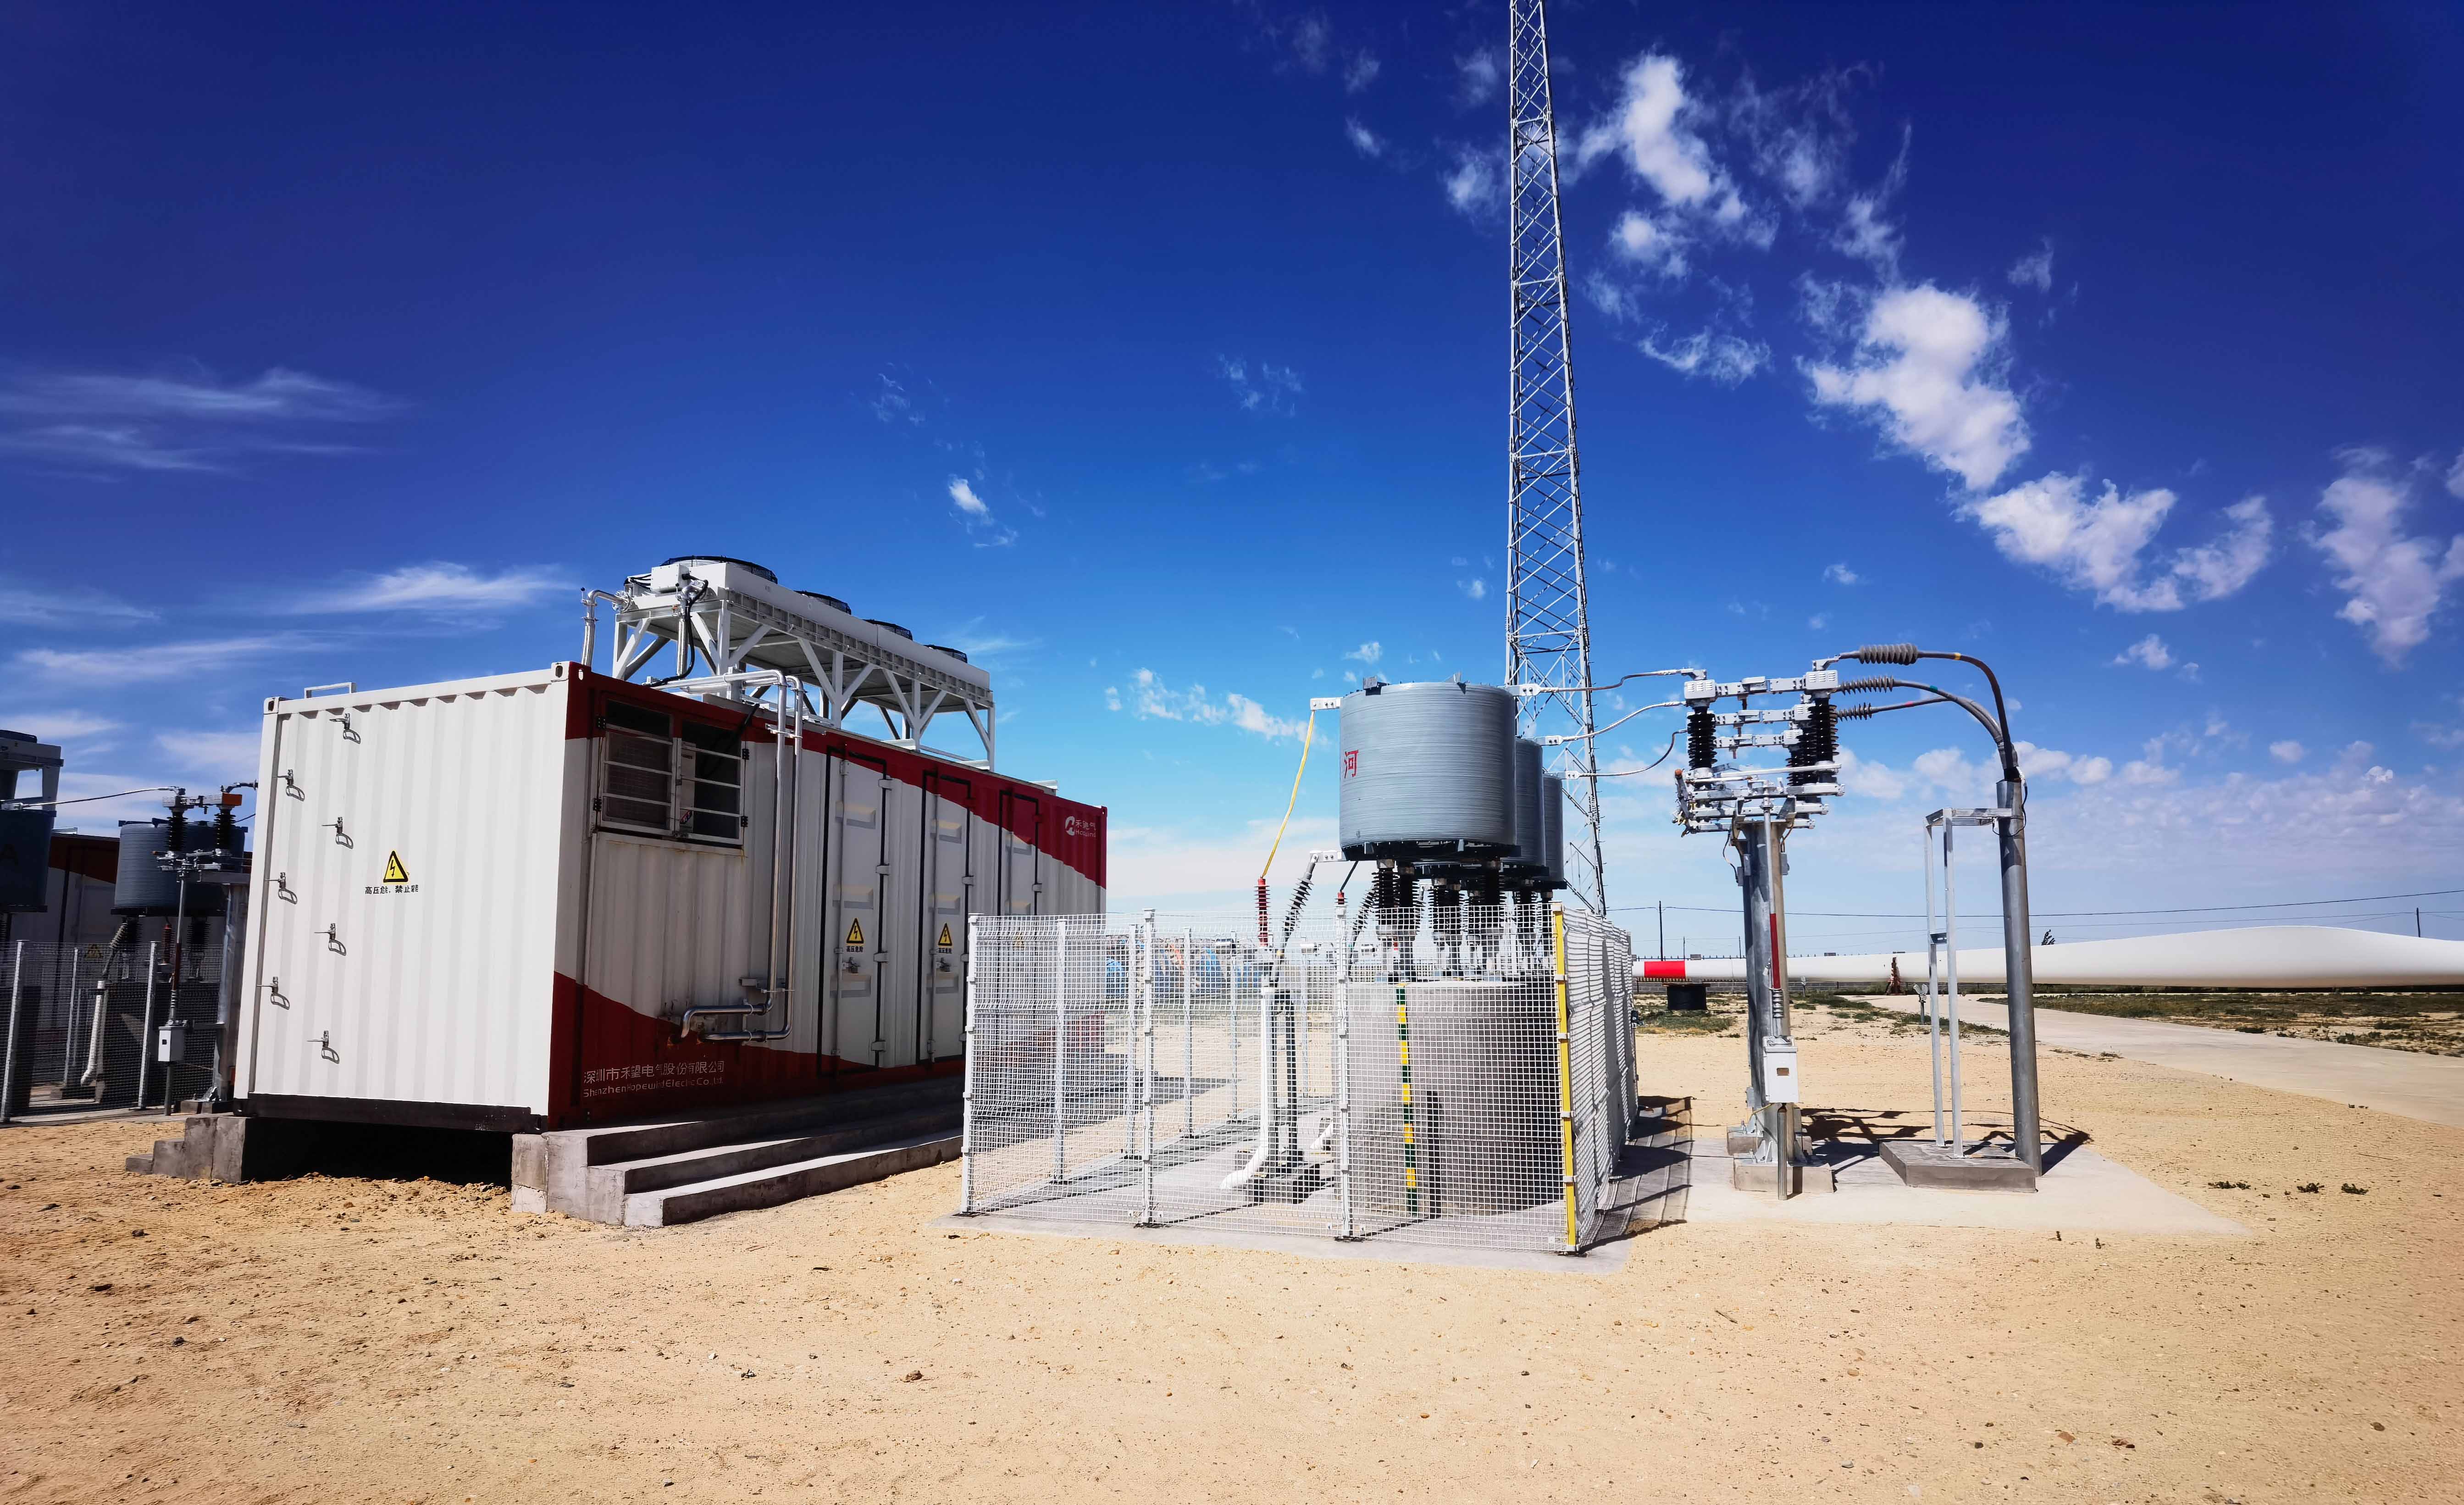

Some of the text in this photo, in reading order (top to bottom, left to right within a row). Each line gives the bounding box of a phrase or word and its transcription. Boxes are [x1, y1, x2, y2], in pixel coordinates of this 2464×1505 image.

[1344, 749, 1359, 778] 河
[583, 1061, 725, 1083] 深圳市禾望电气股份有限公司
